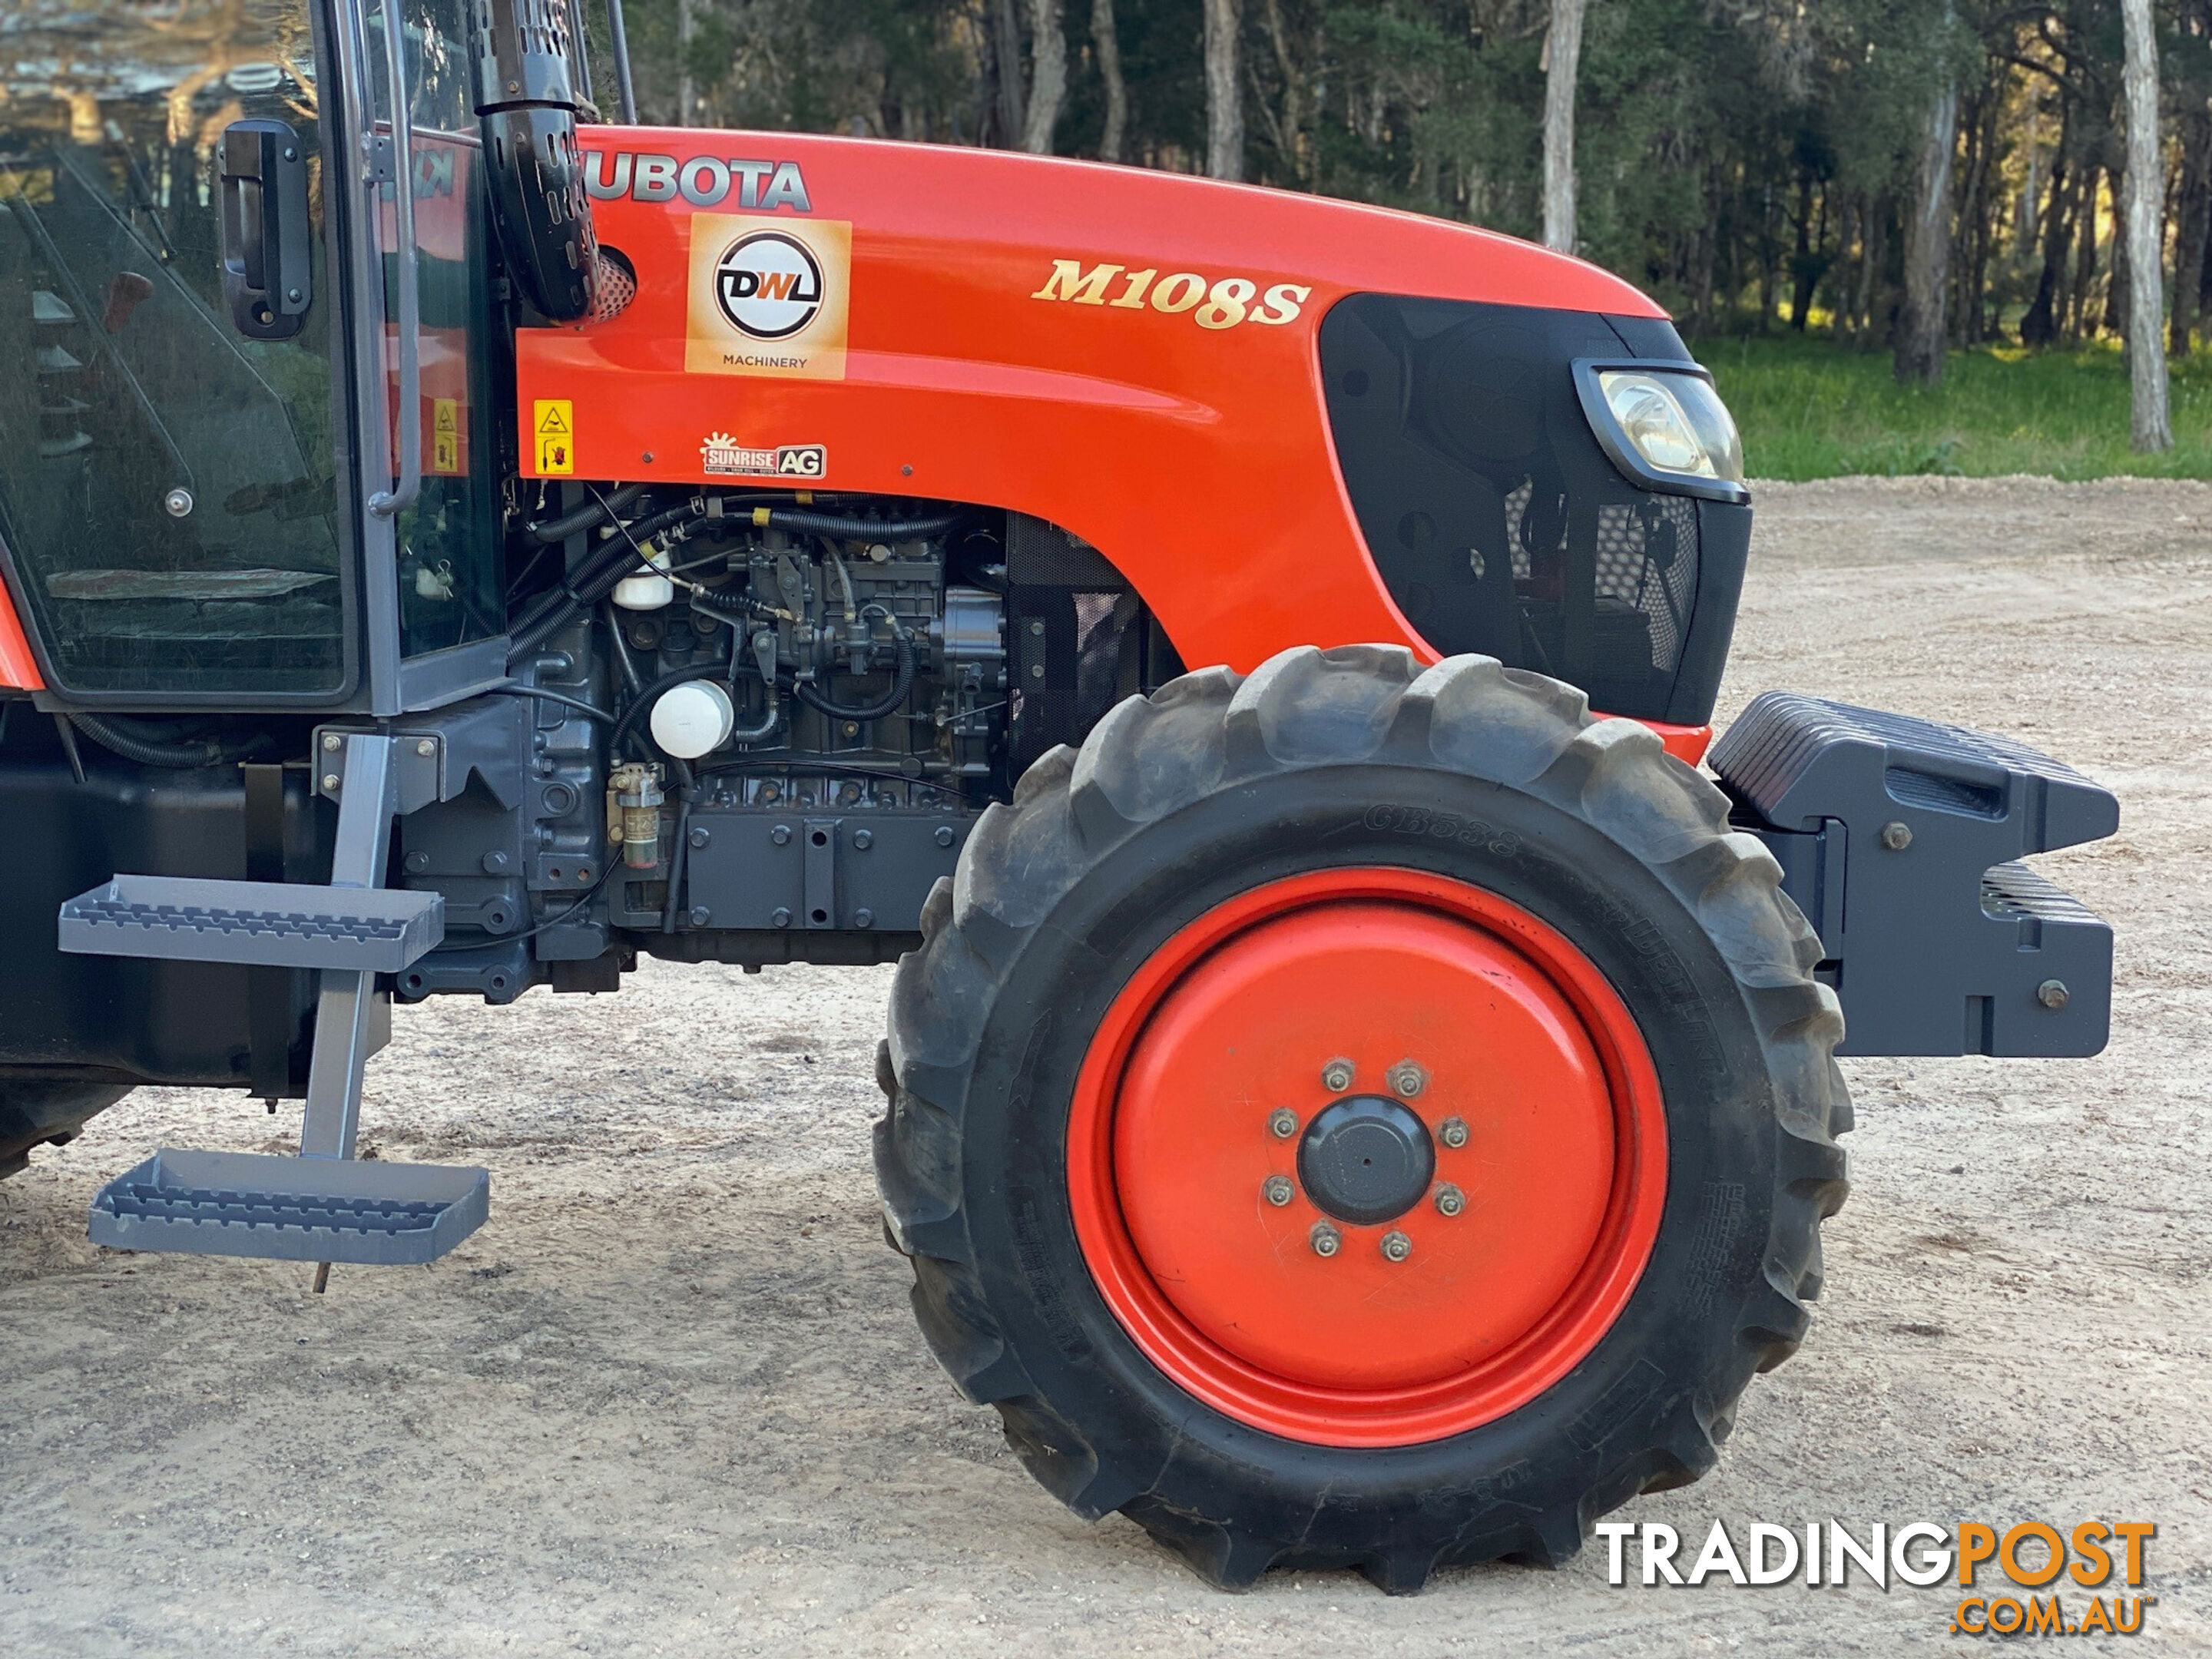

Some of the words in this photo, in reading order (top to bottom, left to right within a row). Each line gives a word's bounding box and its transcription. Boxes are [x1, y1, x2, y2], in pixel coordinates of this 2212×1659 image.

[581, 151, 811, 212] UBOTA
[722, 269, 819, 302] DWL
[1030, 259, 1313, 330] M108S
[723, 354, 808, 369] MACHINERY
[708, 450, 774, 467] SUNRISE
[780, 450, 820, 475] AG
